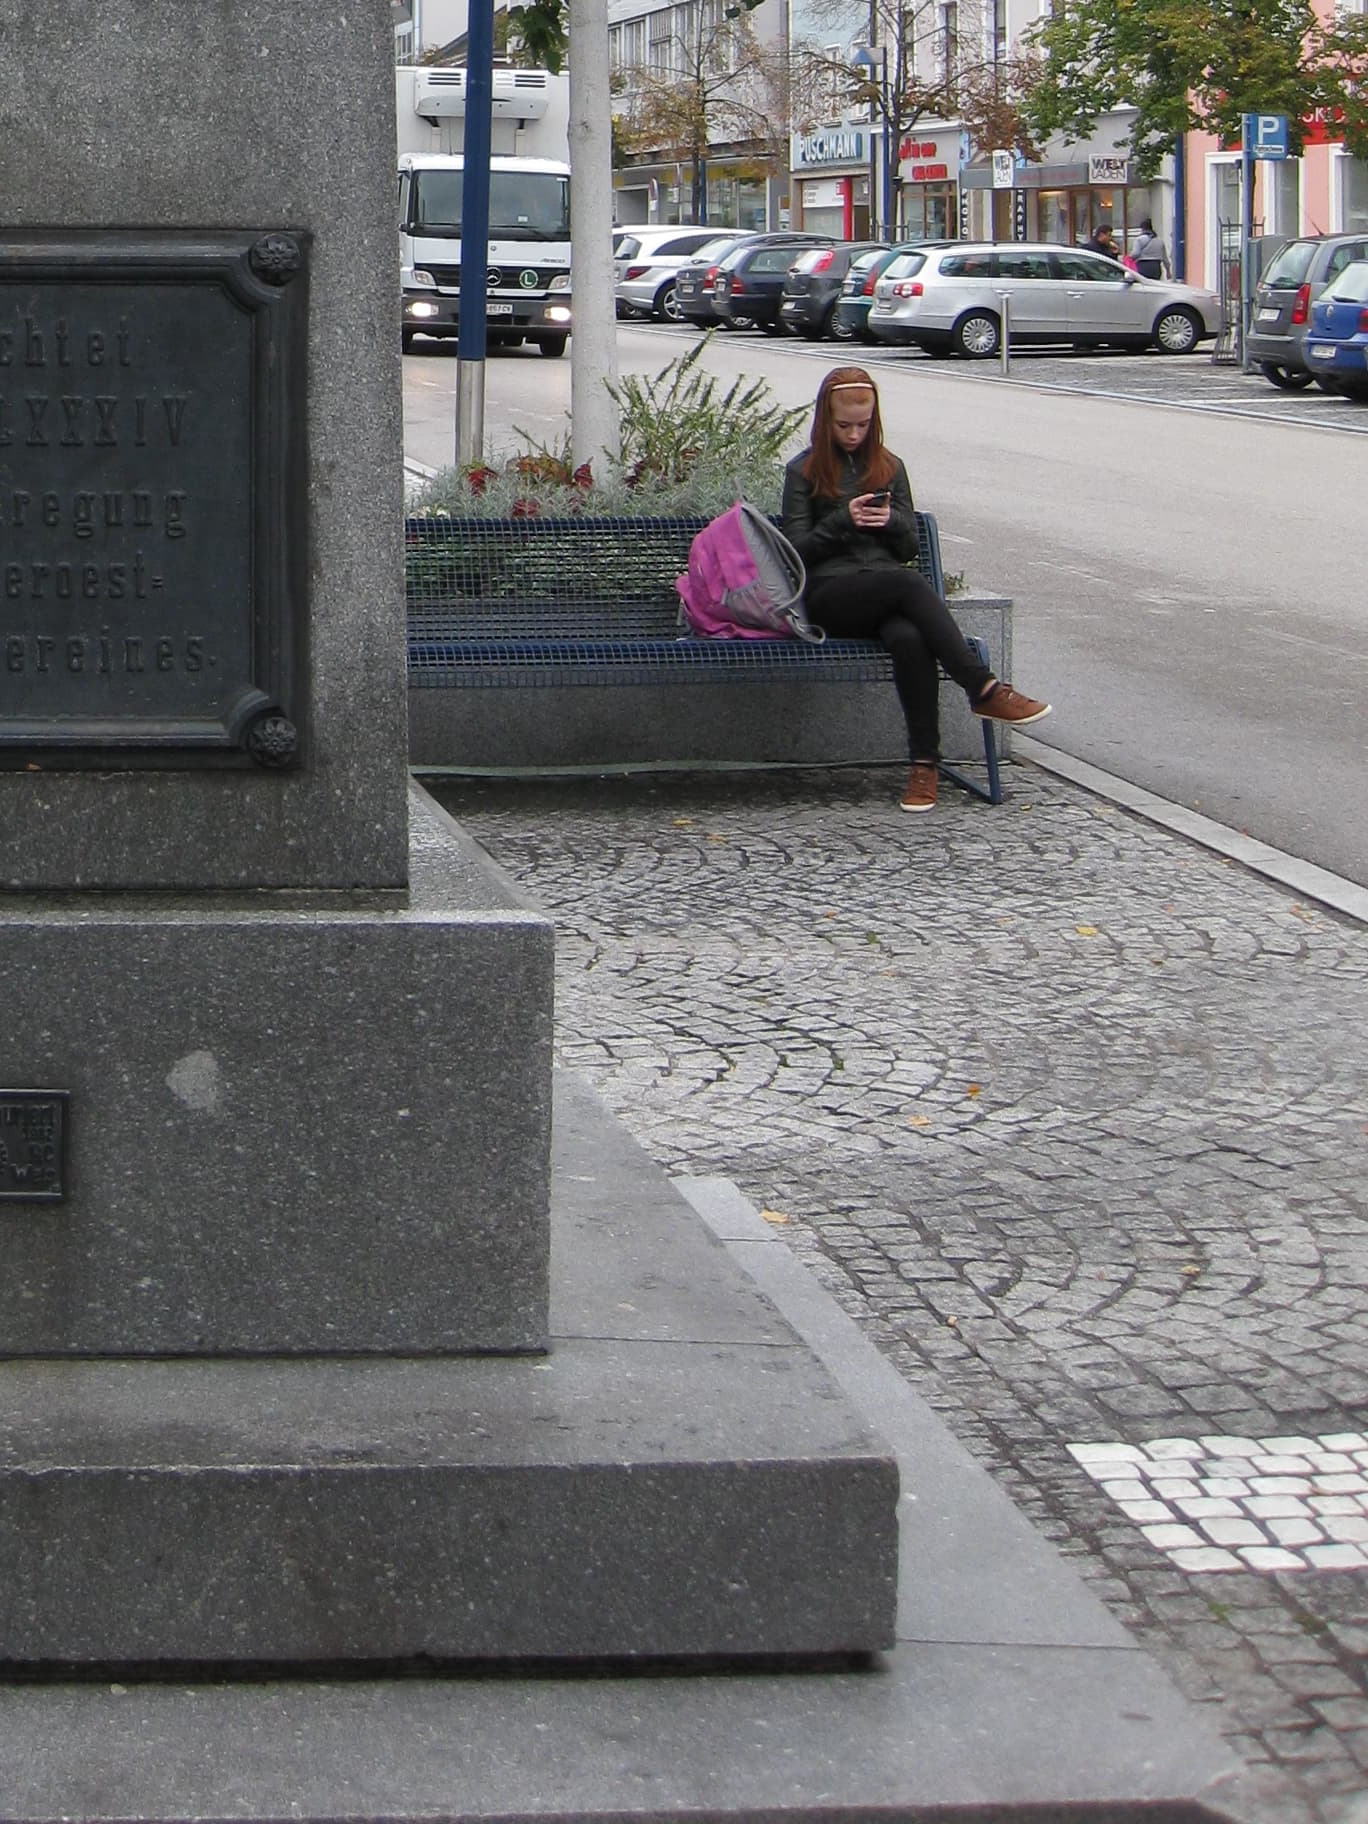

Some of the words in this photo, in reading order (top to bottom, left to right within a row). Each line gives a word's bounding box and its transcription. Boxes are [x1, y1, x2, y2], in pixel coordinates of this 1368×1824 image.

[1258, 116, 1280, 145] P
[800, 133, 860, 164] PUSCHMANN
[1093, 158, 1126, 170] WELT
[1093, 167, 1126, 180] LADEN
